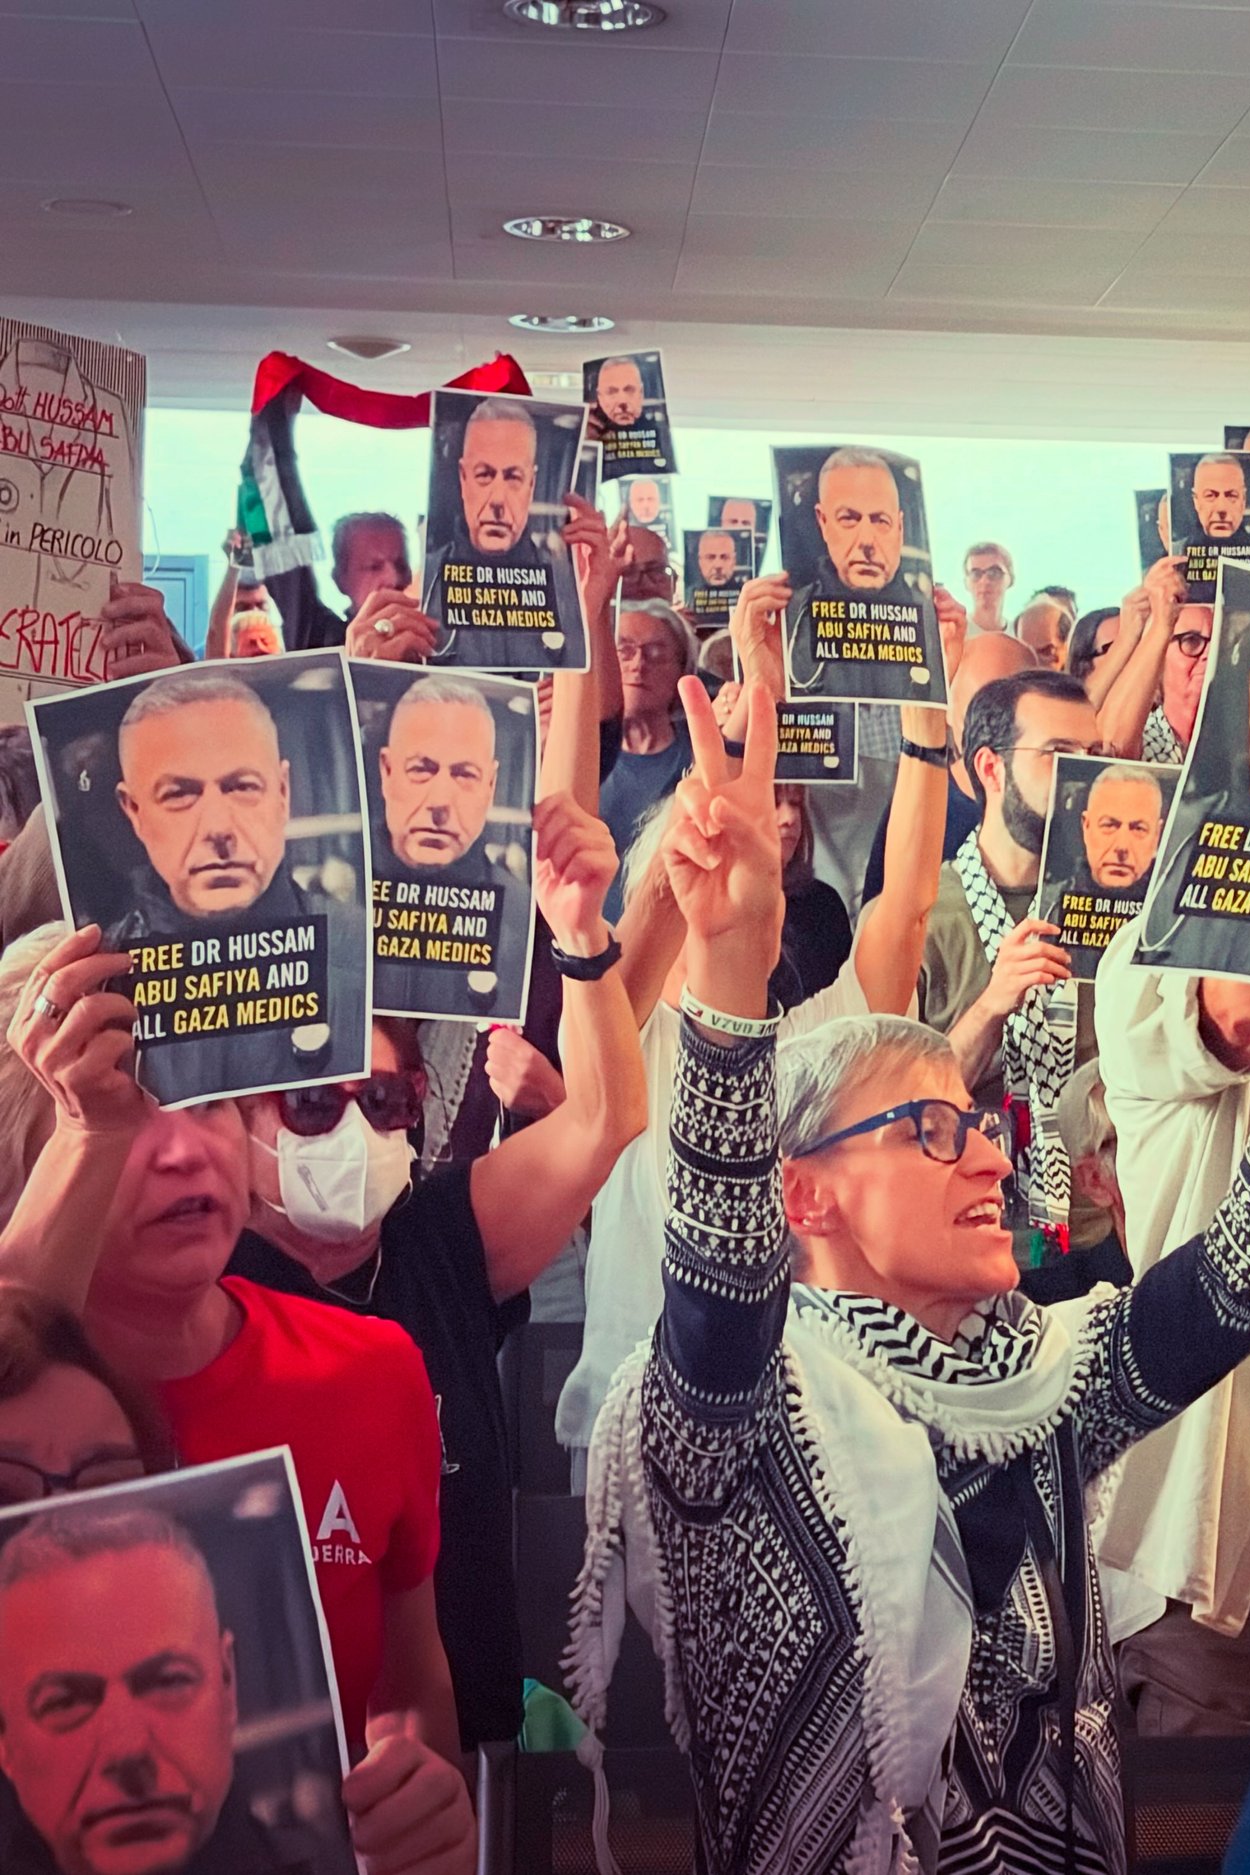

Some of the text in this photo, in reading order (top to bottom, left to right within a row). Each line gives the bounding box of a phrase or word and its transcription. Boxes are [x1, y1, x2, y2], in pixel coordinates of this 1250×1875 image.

[33, 392, 114, 436] HUSSAM
[0, 423, 31, 456] BU
[5, 522, 123, 565] in PERICOLO
[444, 564, 547, 586] FREE DR HUSSAM
[447, 586, 546, 607] ABU SAFIYA AND
[447, 608, 555, 628] ALL GAZA MEDICS
[812, 601, 918, 623] FREE DR HUSSAM
[817, 621, 916, 643] ABU SAFIYA AND
[816, 641, 923, 664] ALL GAZA MEDICS
[782, 713, 834, 726] DR HUSSAM
[813, 728, 832, 740] AND
[778, 742, 798, 753] AZA
[1199, 822, 1244, 850] FREE
[1192, 854, 1229, 879] ABU
[396, 882, 420, 904] DR
[424, 884, 496, 912] HUSSAM
[1062, 894, 1143, 916] FREE DR HUSS
[1179, 883, 1208, 909] ALL
[387, 909, 448, 935] SAFIYA
[452, 915, 488, 938] AND
[1063, 913, 1087, 928] ABU
[128, 925, 315, 974] FREE DR HUSSAM
[1059, 930, 1079, 945] ALL
[377, 935, 492, 966] GAZA MEDICS
[133, 960, 309, 1007] ABU SAFIYA AND
[132, 992, 319, 1041] ALL GAZA MEDICS
[315, 1478, 361, 1544] A
